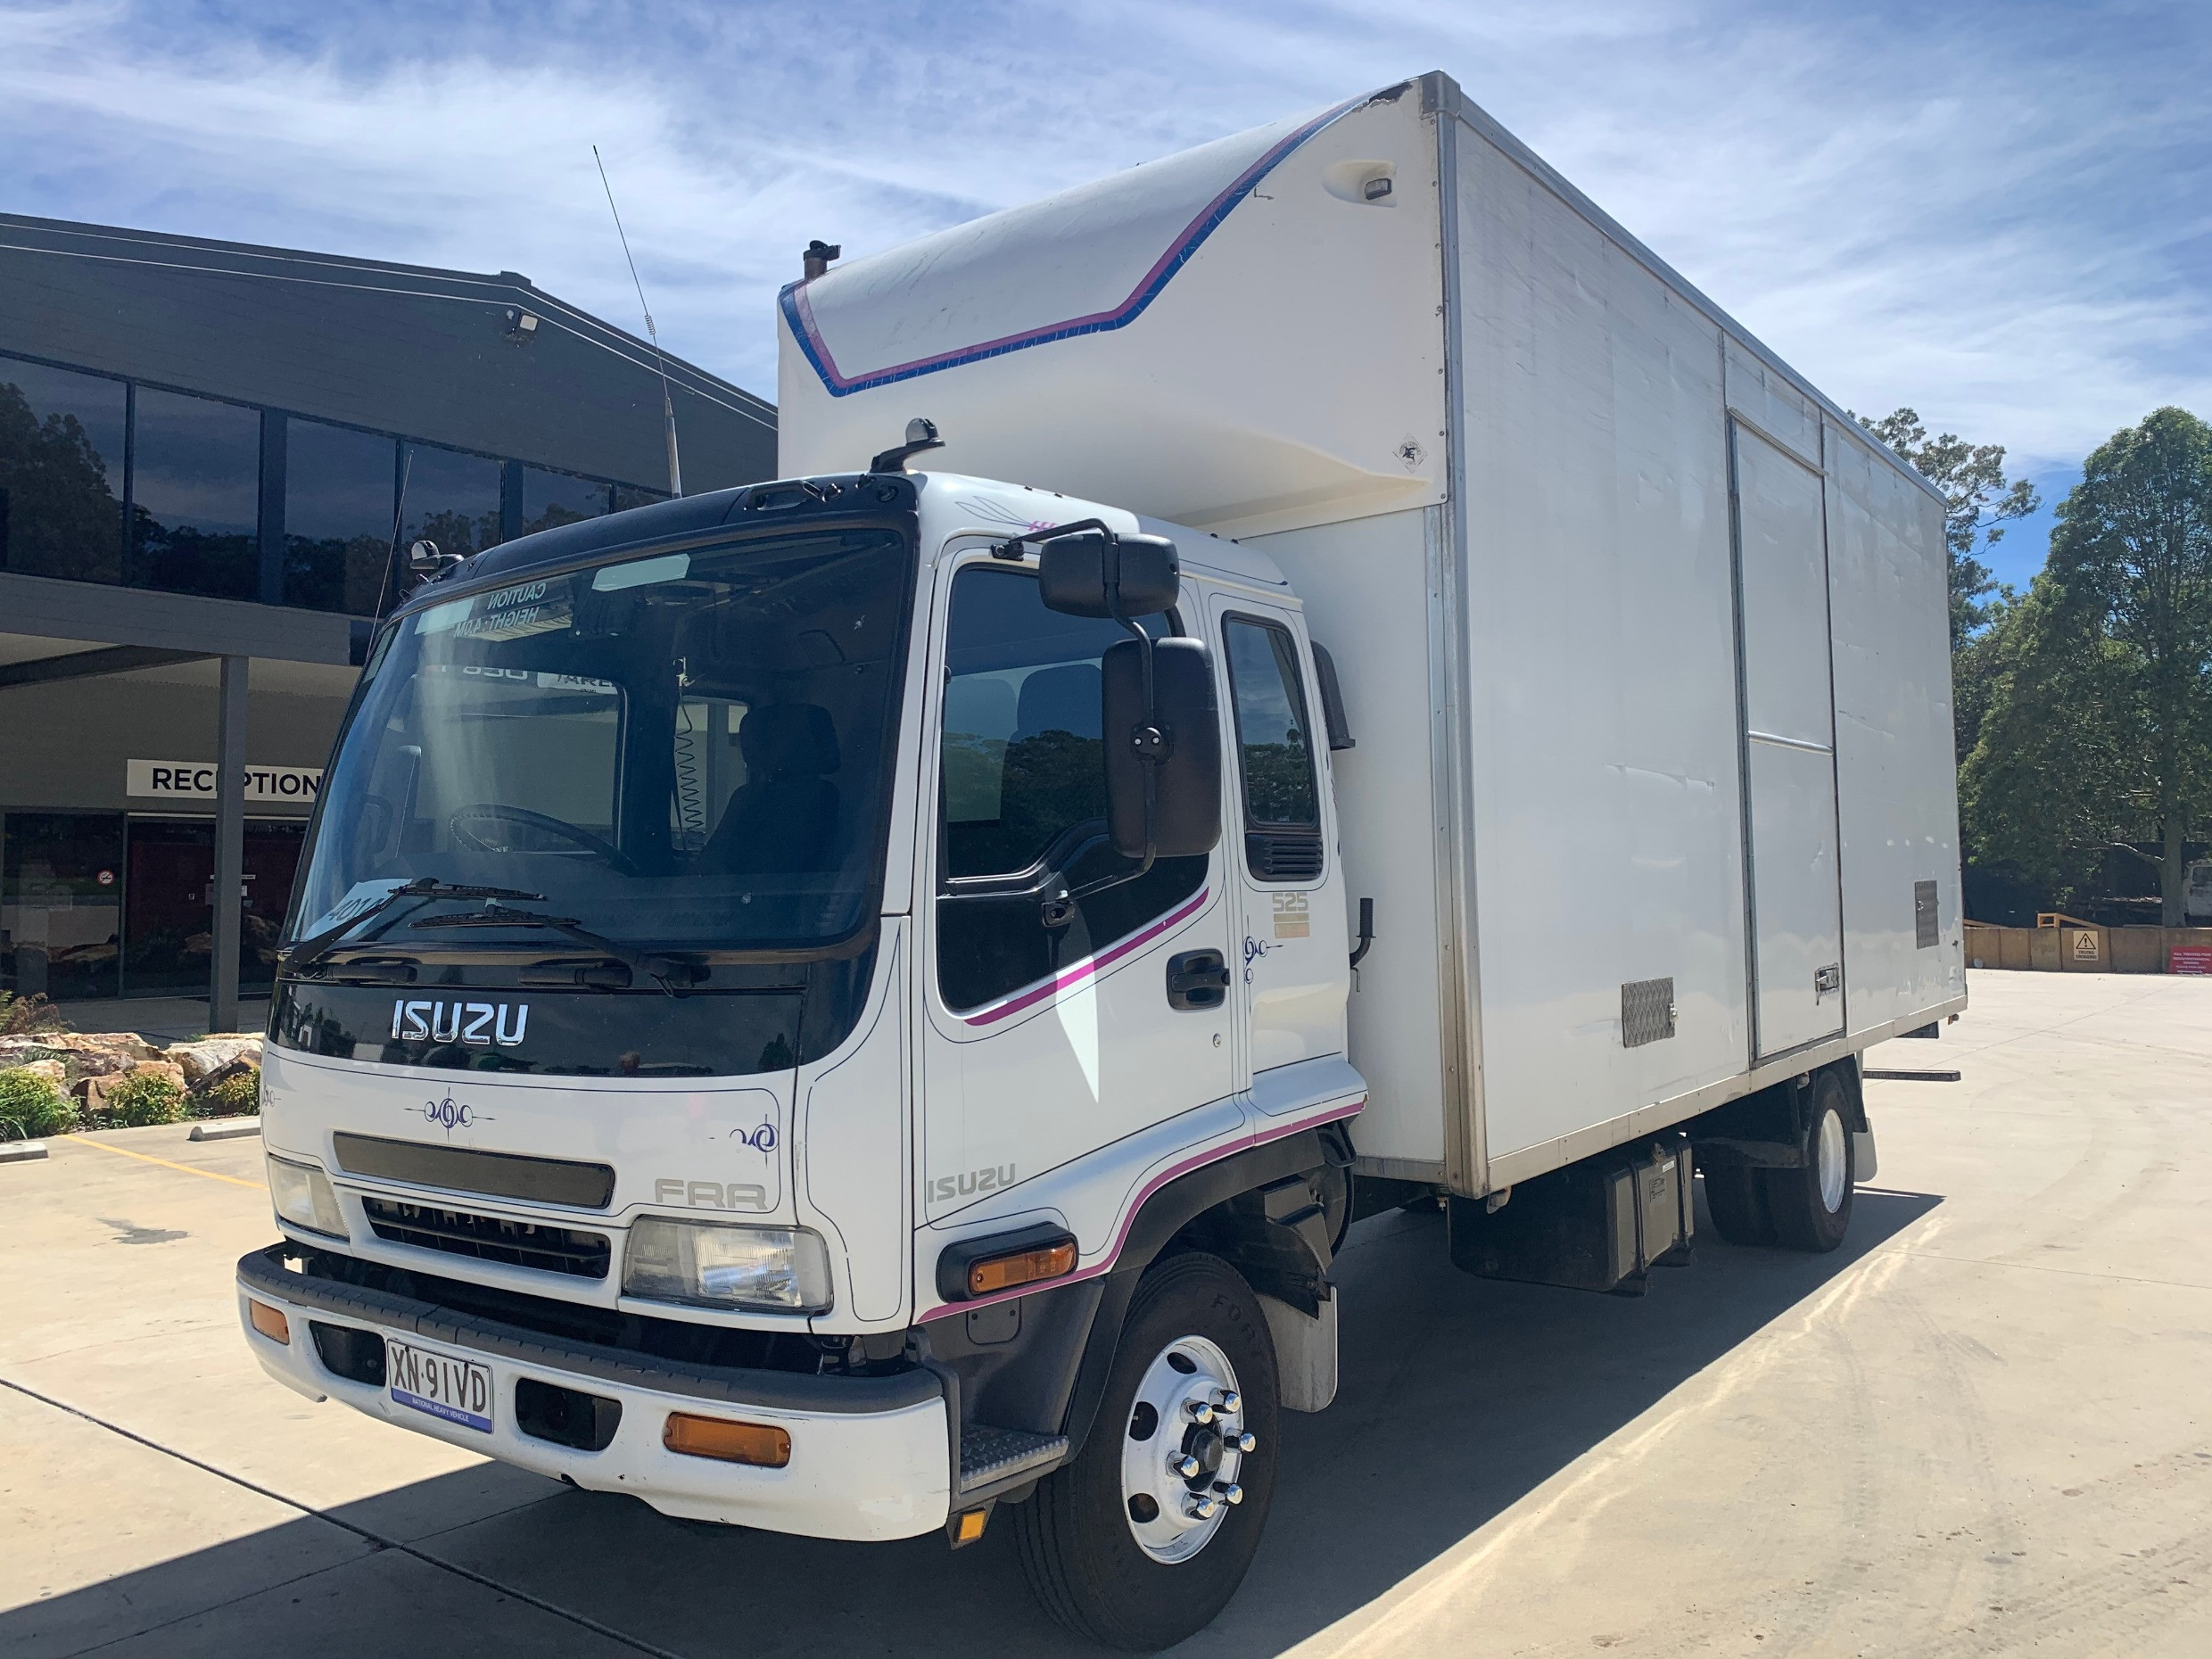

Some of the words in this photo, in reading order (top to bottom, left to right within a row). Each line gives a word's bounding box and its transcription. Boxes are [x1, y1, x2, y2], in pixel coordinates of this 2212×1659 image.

[152, 767, 321, 796] RECTION
[1272, 892, 1308, 912] 525
[391, 999, 530, 1046] ISUZU
[655, 1178, 768, 1210] FRR
[928, 1162, 1016, 1203] ISUZU
[411, 1397, 433, 1410] NATIONAL
[433, 1405, 450, 1416] HEAVY
[449, 1410, 470, 1423] VEHICLE
